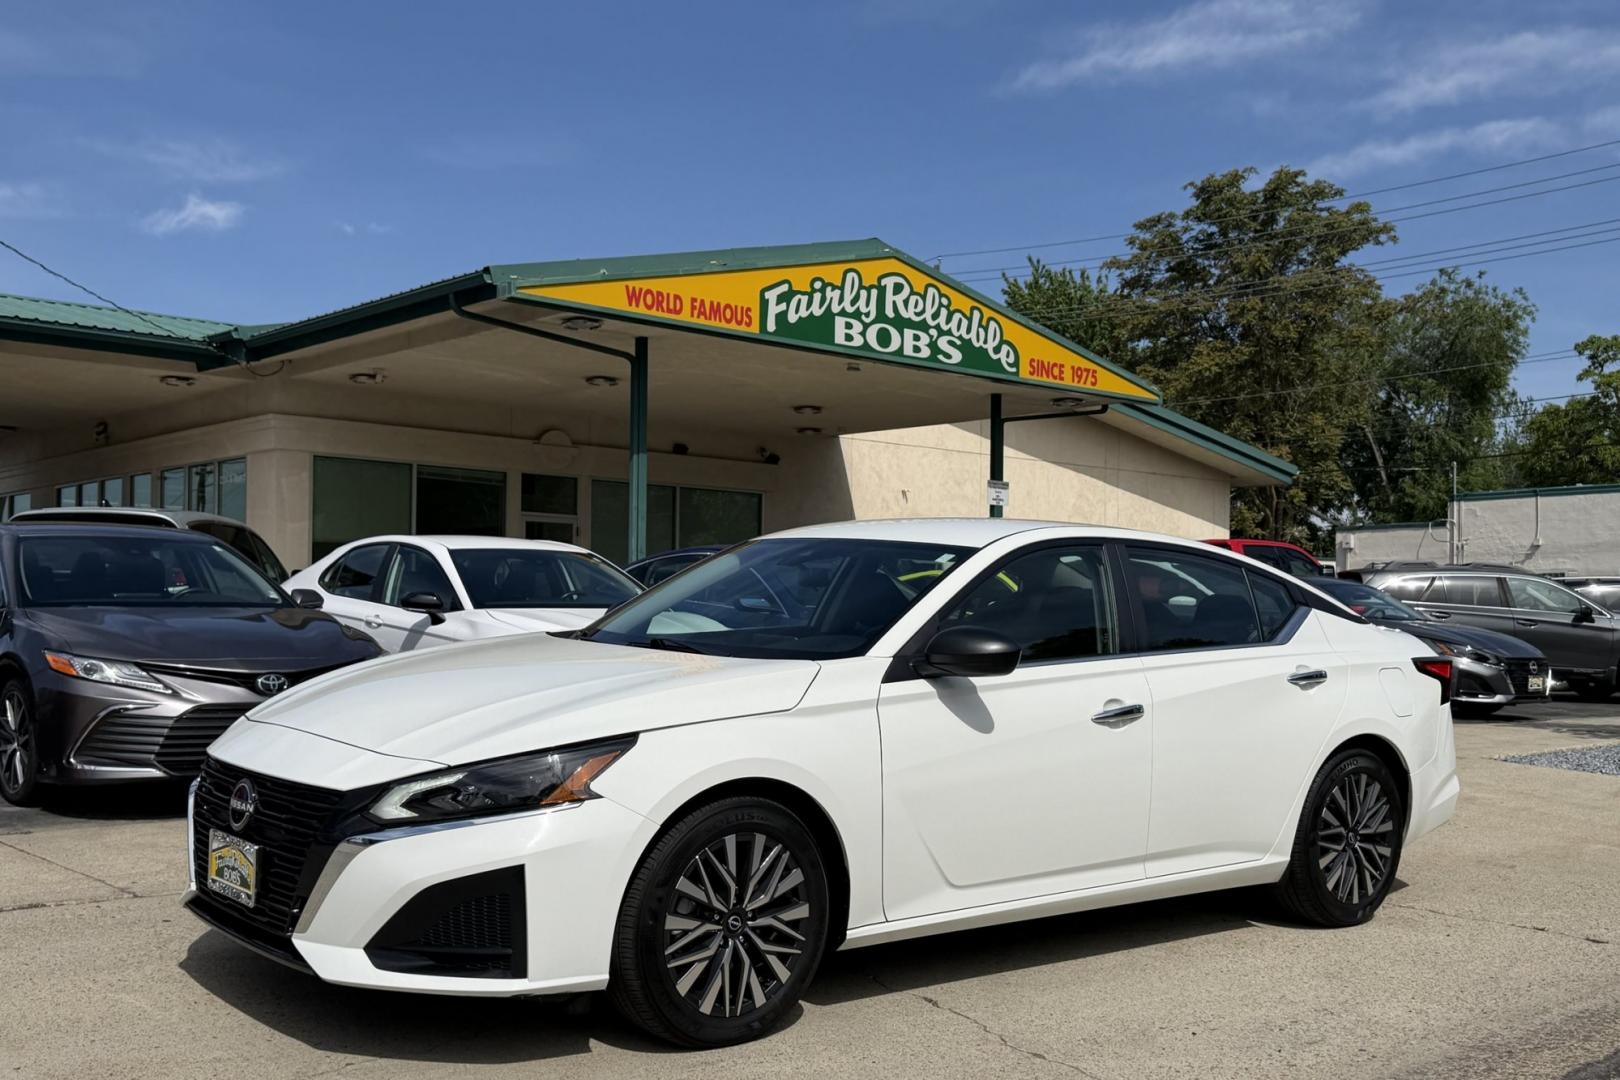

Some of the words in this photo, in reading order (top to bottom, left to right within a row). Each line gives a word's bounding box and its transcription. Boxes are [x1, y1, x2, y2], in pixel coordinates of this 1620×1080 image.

[625, 285, 683, 315] WORLD
[690, 297, 753, 327] FAMOUS
[764, 271, 878, 333] Fairly
[880, 275, 1017, 373] Reliable
[834, 315, 963, 364] BOB'S
[1028, 358, 1065, 381] SINCE
[1070, 365, 1098, 387] 1975
